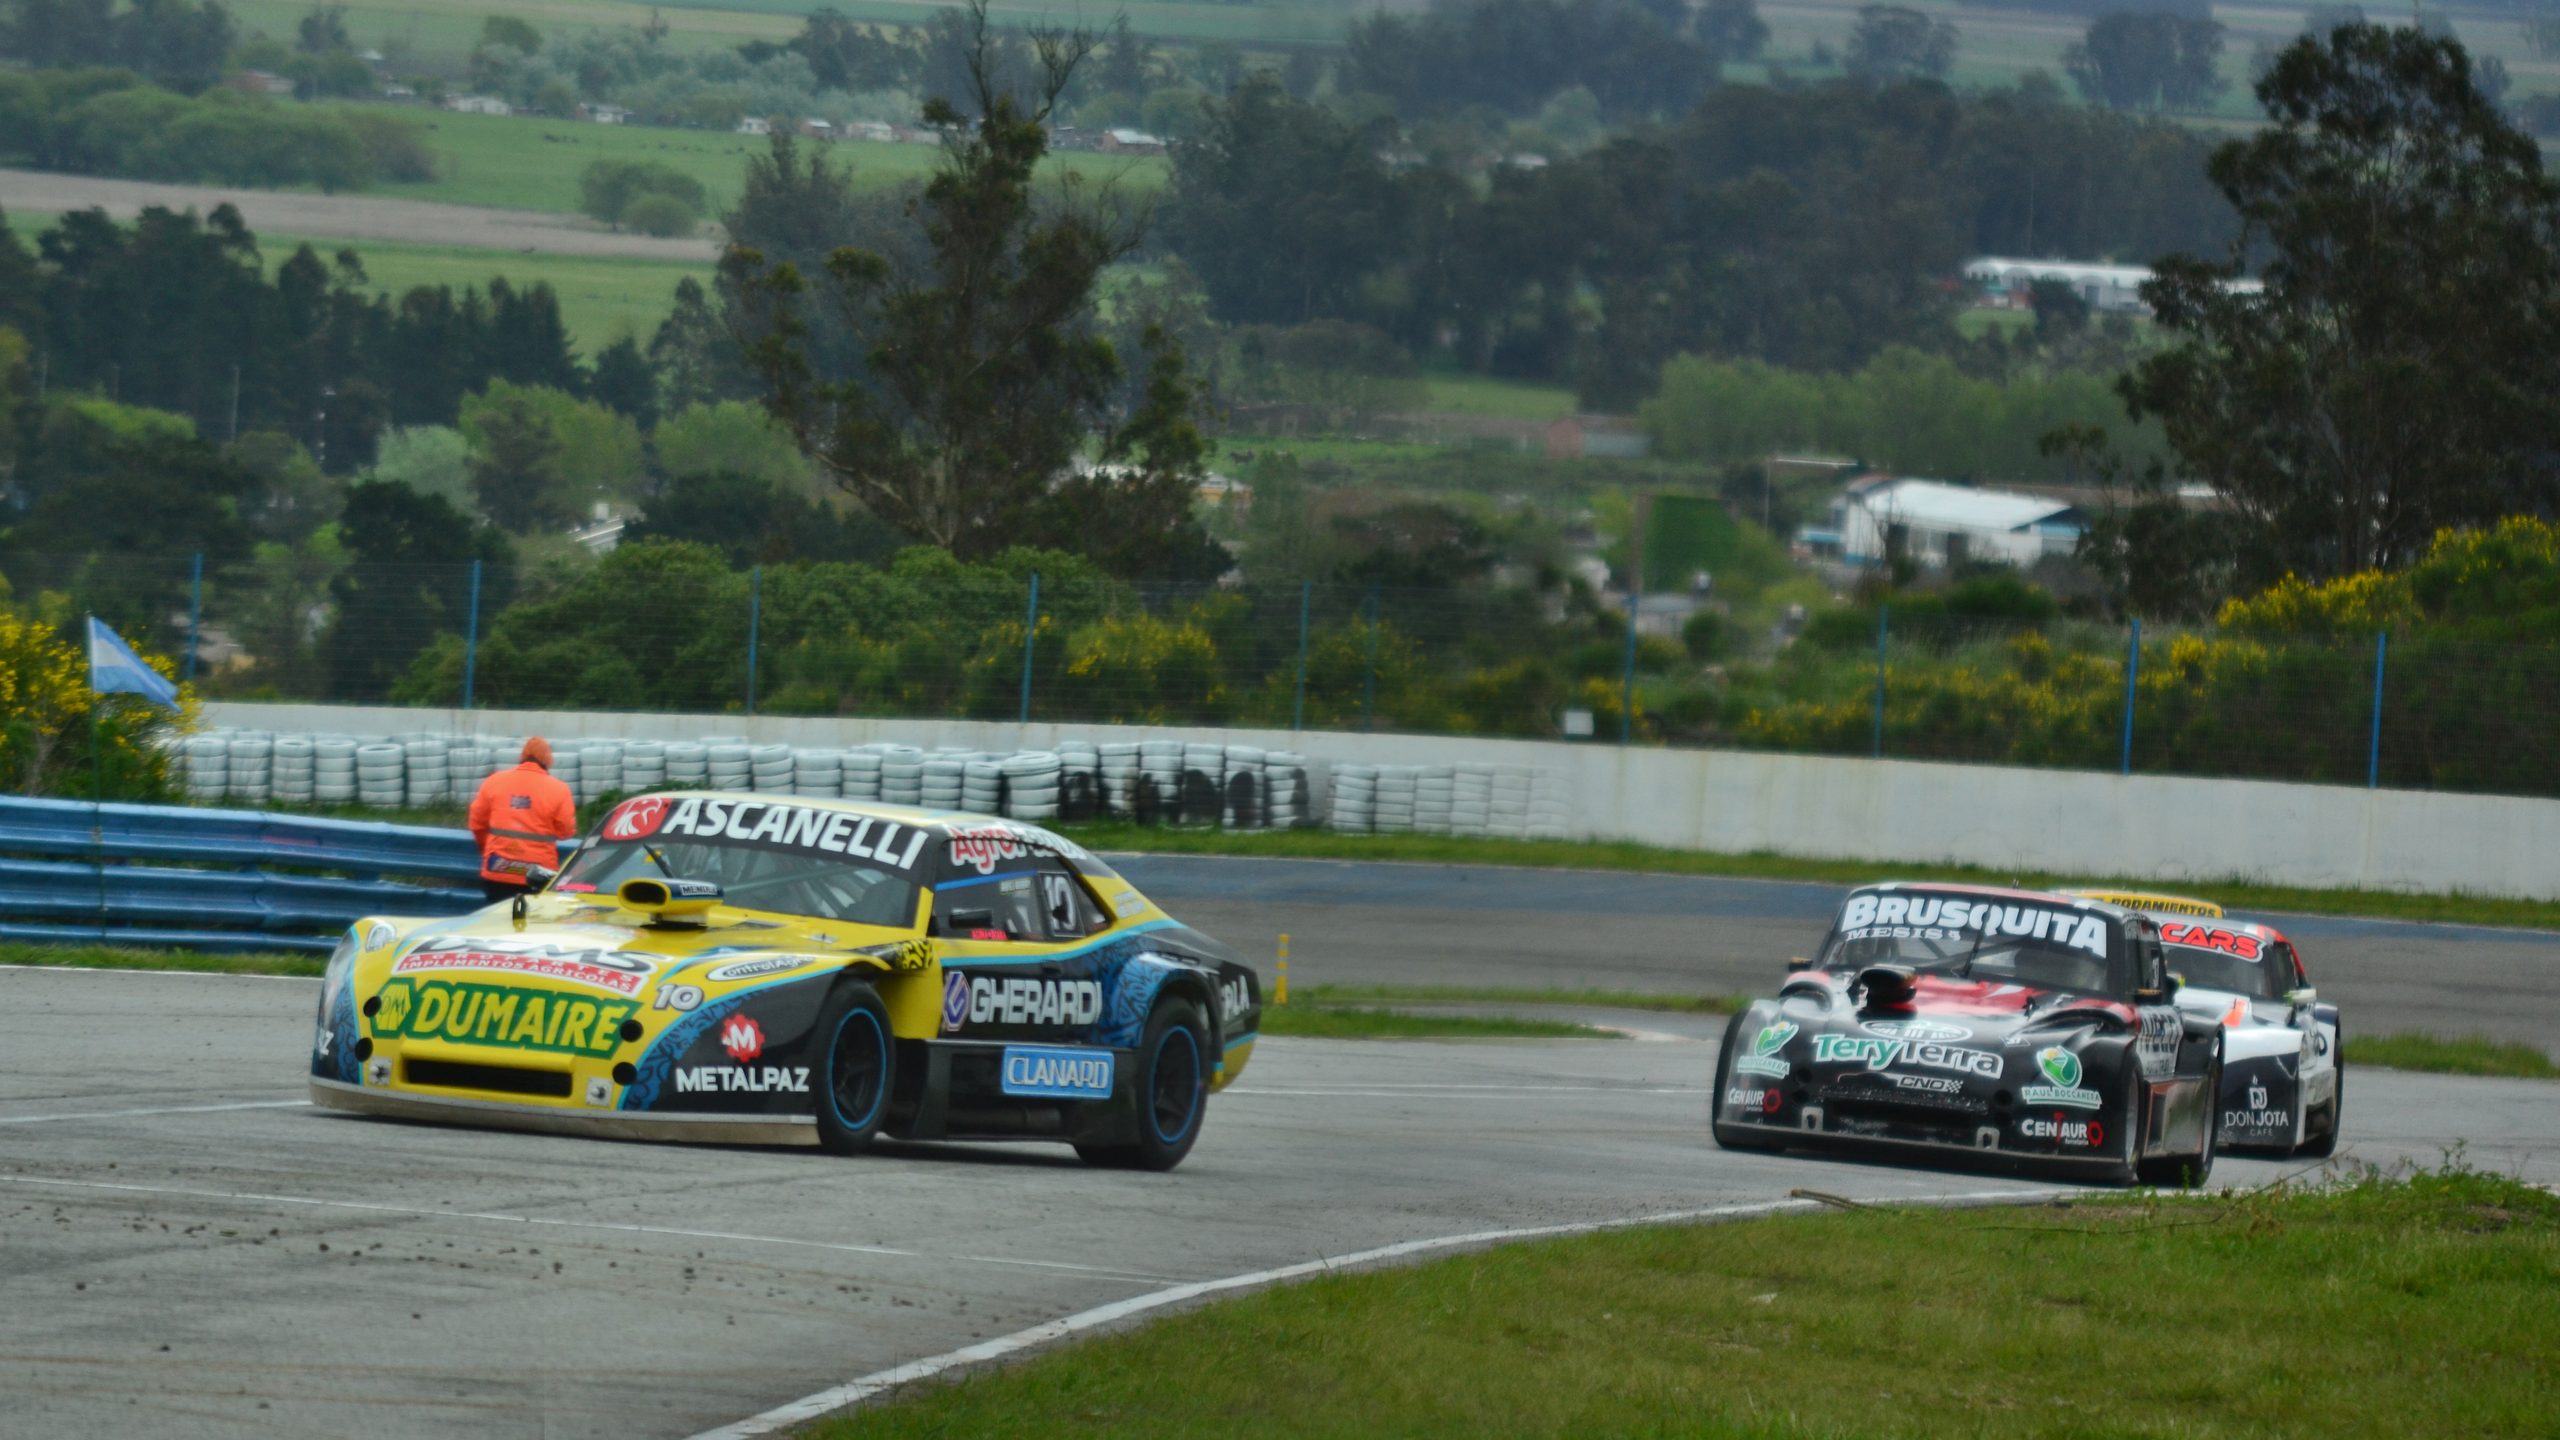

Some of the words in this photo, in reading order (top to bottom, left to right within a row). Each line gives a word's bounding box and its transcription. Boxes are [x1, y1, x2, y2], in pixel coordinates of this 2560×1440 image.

[661, 797, 929, 870] ASCANELLI
[1841, 895, 2107, 959] BRUSQUITA
[400, 956, 524, 972] IMPLEMENTOS
[527, 963, 633, 994] AGRICOLAS
[653, 983, 705, 1012] 10
[970, 976, 1103, 1024] GHERARDI
[412, 986, 630, 1051] DUMAIRE
[675, 1066, 810, 1092] METALPAZ
[1006, 1055, 1109, 1090] CLANARD
[1899, 1076, 1946, 1091] CNO
[2021, 1111, 2104, 1147] CENTAURO
[2224, 1110, 2255, 1127] DON
[2256, 1110, 2289, 1127] JOTA
